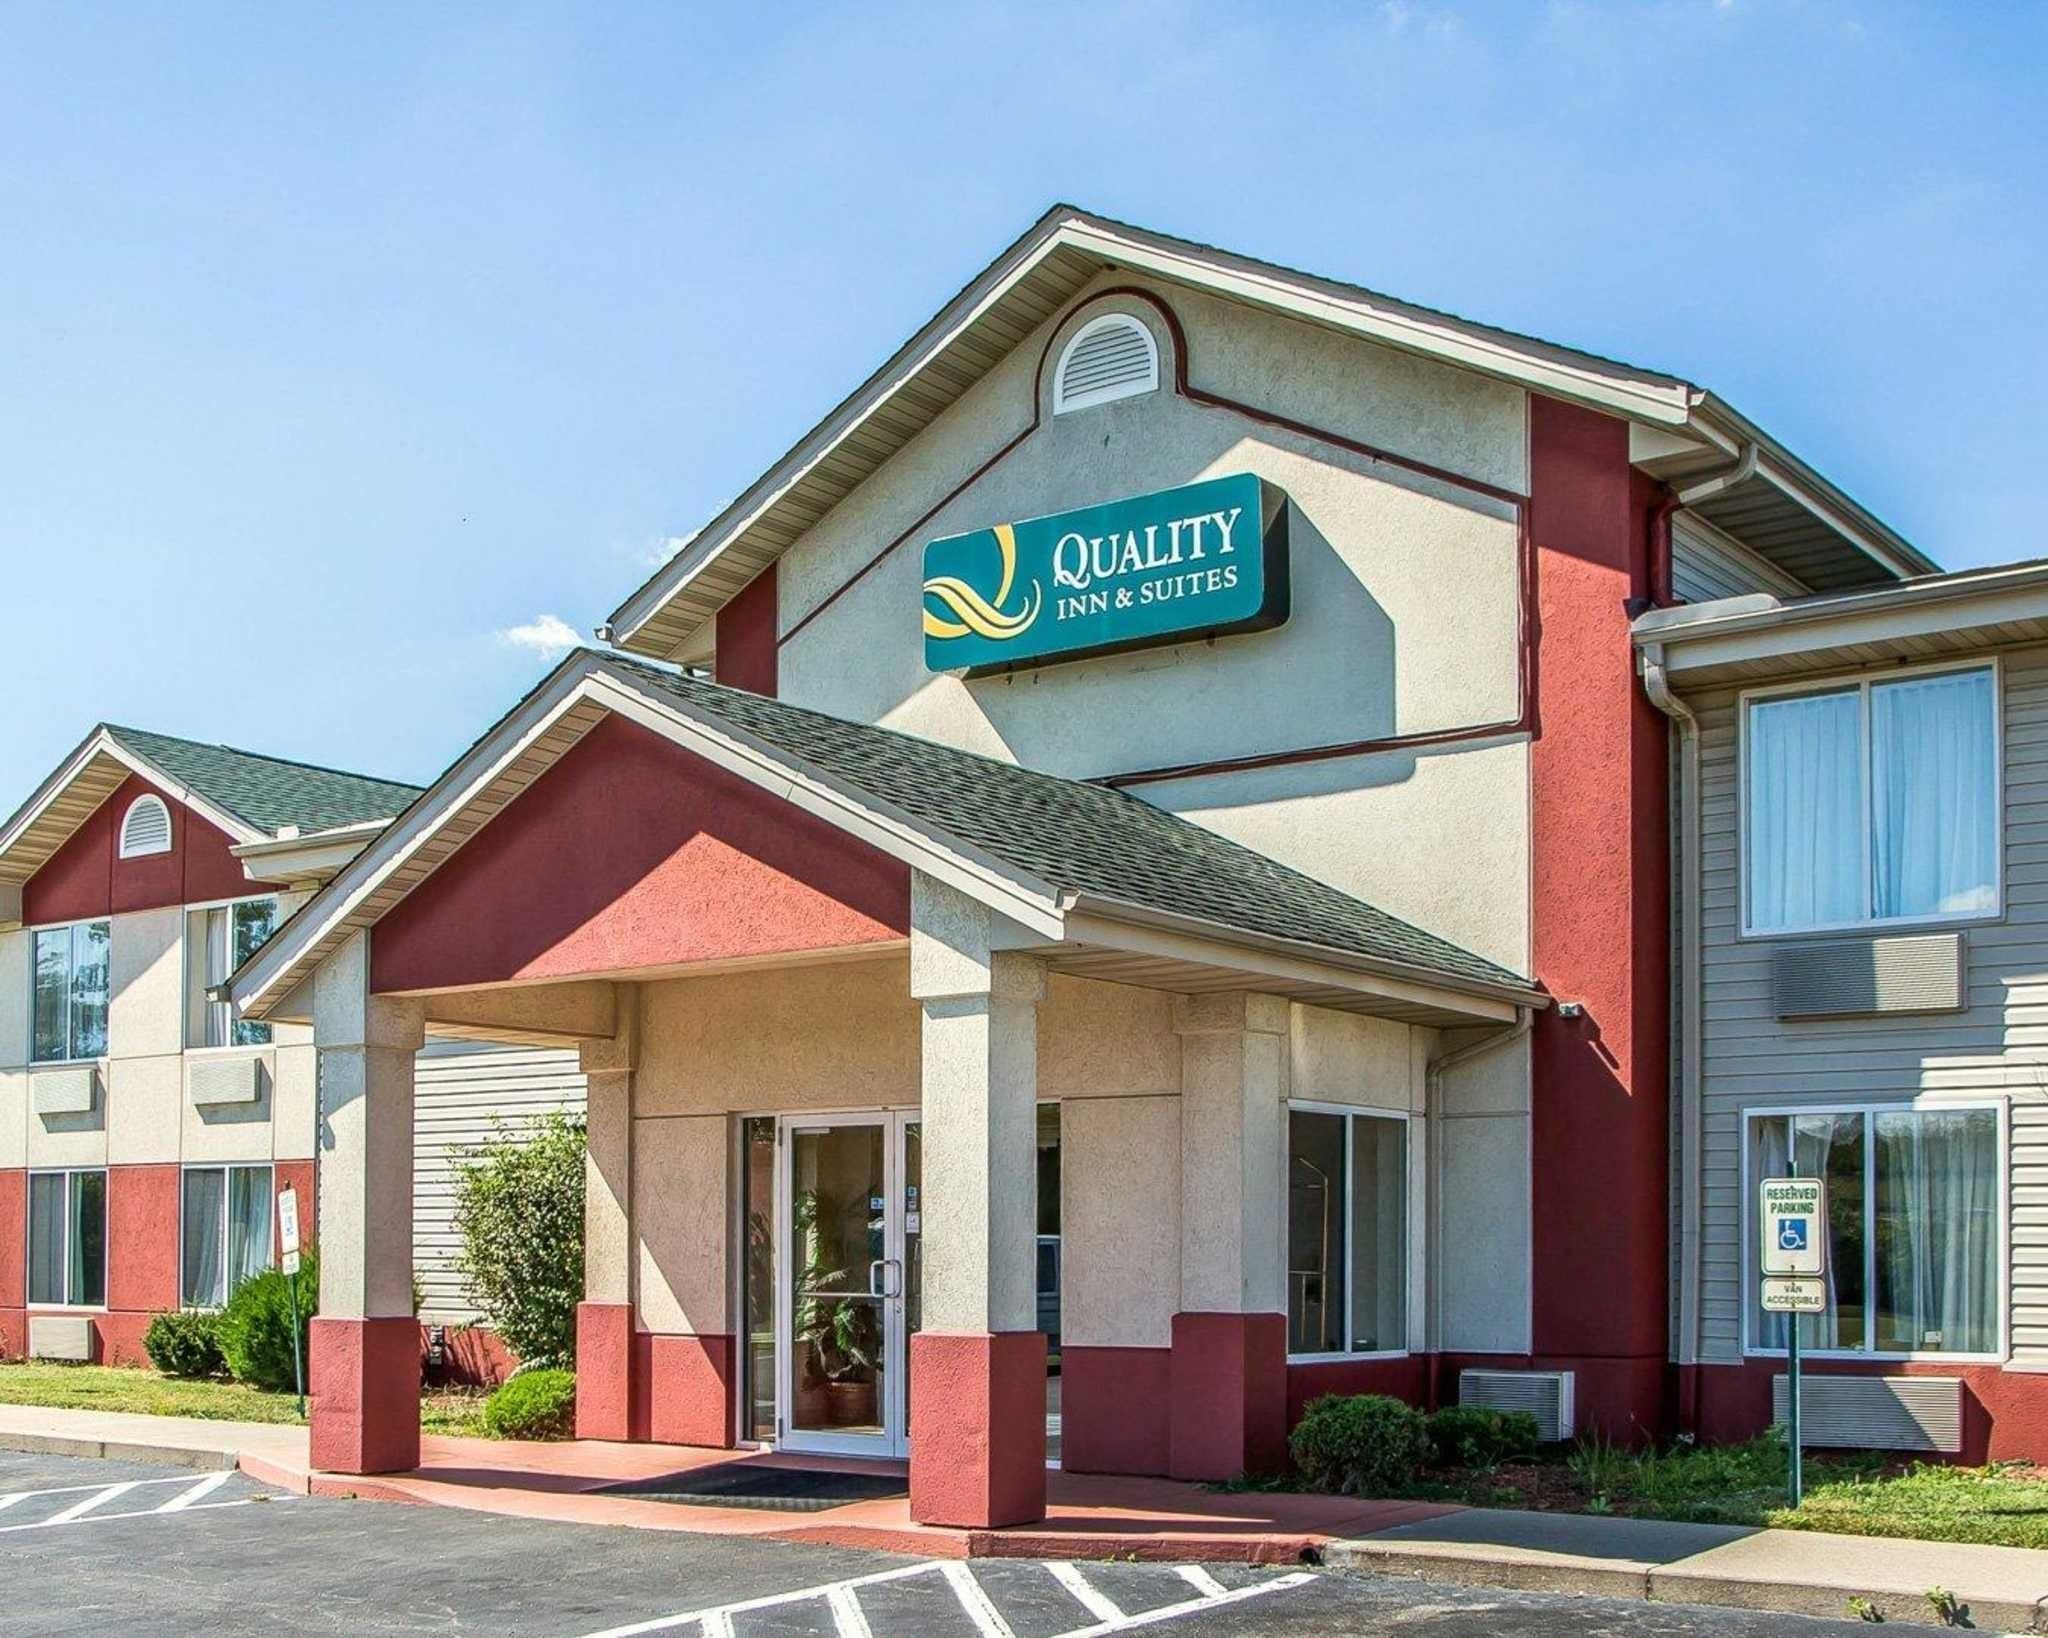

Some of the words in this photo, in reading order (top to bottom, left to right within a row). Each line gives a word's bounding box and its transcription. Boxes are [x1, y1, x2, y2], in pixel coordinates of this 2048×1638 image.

[1053, 508, 1242, 590] QUALITY
[1057, 590, 1108, 621] INN
[1115, 587, 1133, 608] &
[1140, 565, 1238, 605] SUITES
[1767, 1188, 1817, 1200] RESERVED
[1770, 1202, 1814, 1214] PARKING
[1784, 1285, 1802, 1293] VAN
[1767, 1296, 1820, 1305] ACCESSIBLE
